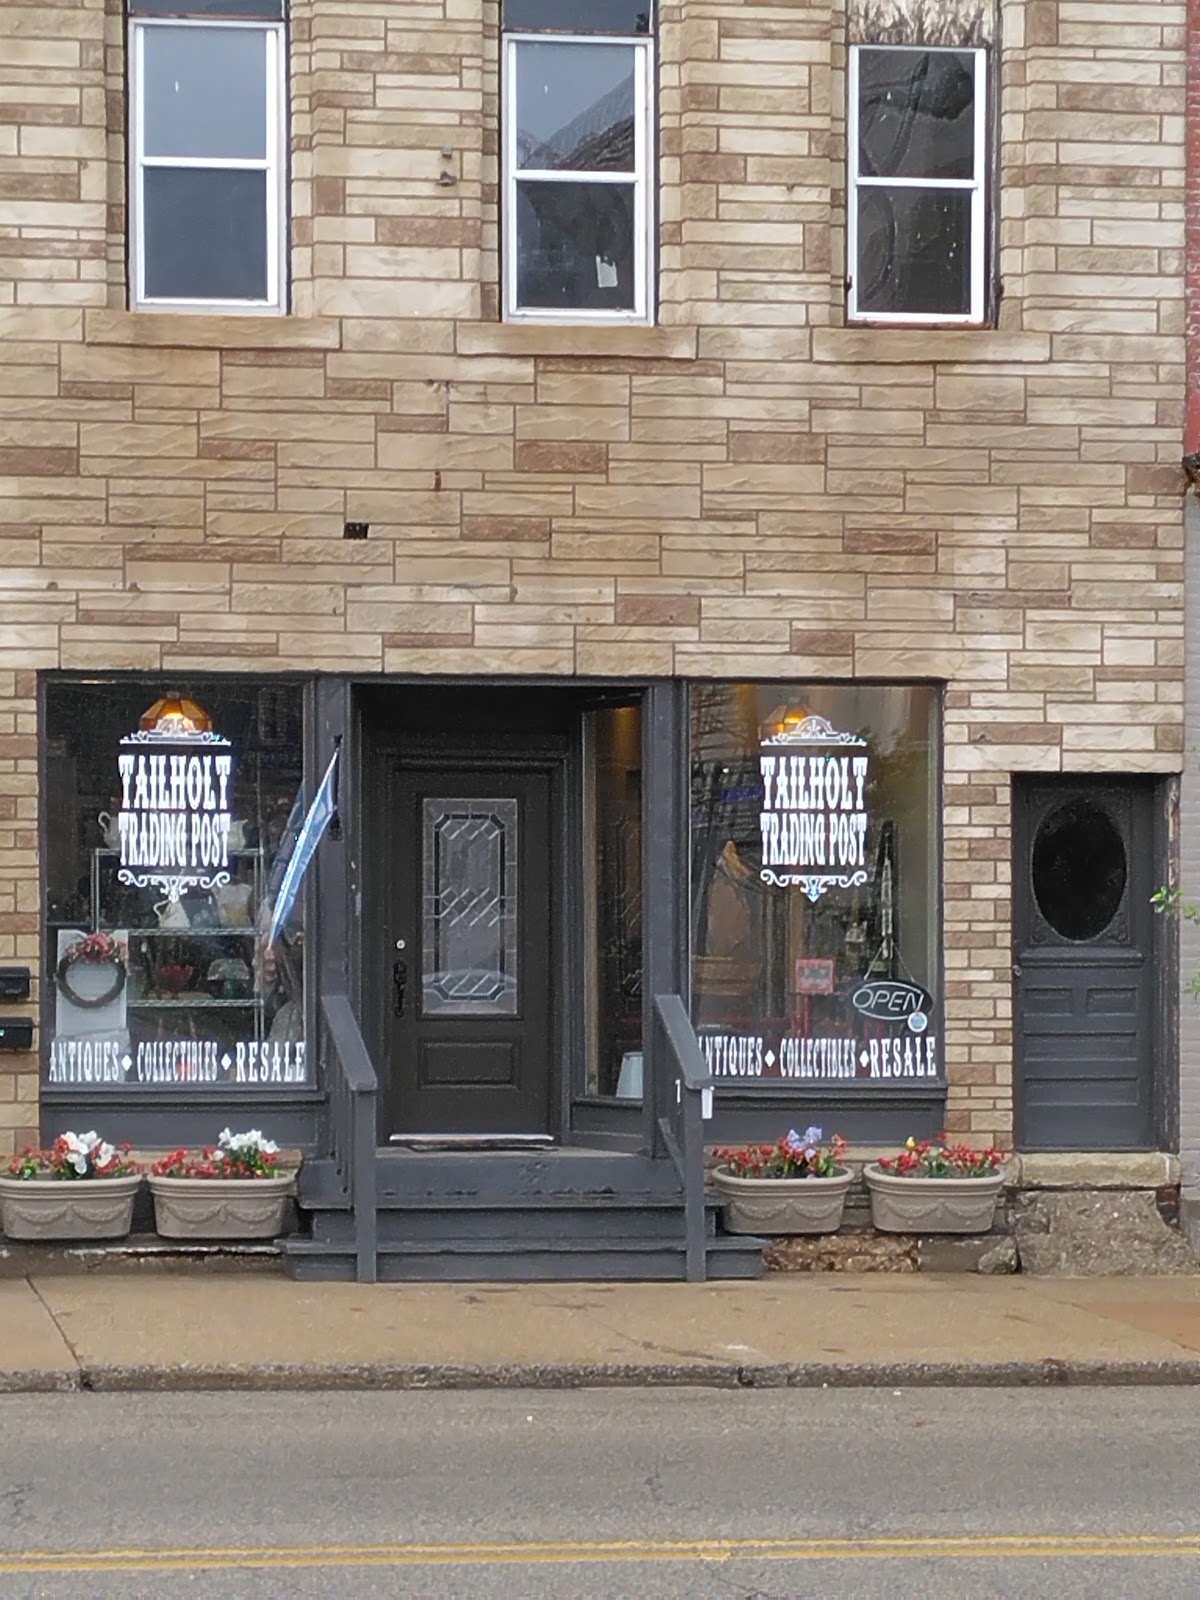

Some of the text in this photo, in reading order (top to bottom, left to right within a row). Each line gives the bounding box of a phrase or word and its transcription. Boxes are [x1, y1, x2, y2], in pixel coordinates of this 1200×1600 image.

[118, 754, 232, 810] TAILHOLT
[760, 756, 868, 810] TAILHOLT
[118, 812, 231, 867] TRADING POST
[760, 812, 867, 866] TRADING POST
[852, 988, 924, 1012] OPEN
[48, 1041, 306, 1082] ANTIQUES COLLECTIBLES RESALE
[698, 1035, 937, 1078] NTIQUES COLLECTIBLES RESALE
